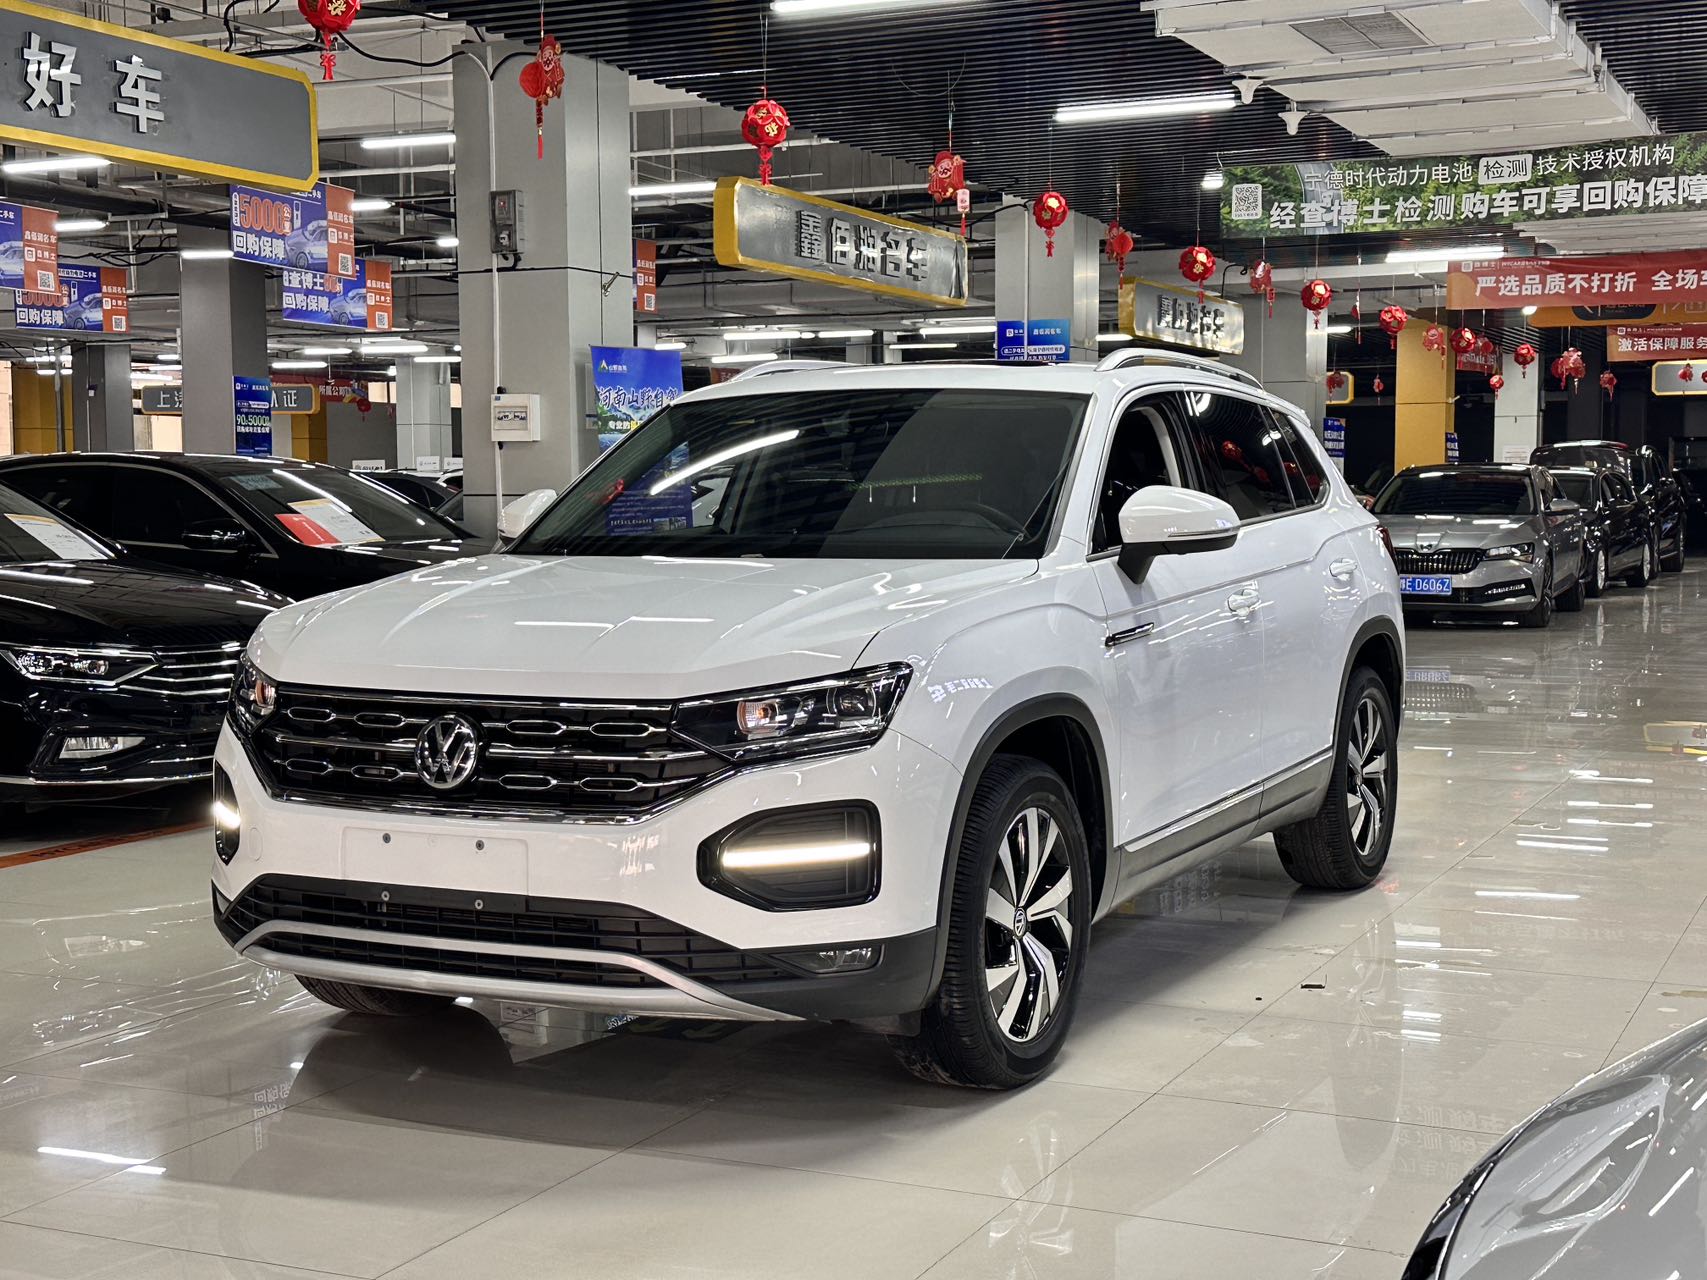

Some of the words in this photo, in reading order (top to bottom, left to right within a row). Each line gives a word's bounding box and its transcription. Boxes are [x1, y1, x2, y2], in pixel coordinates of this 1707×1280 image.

[22, 31, 165, 133] 好车
[1304, 163, 1473, 191] 宁德时代动力电池
[1483, 158, 1527, 180] 检测
[1537, 143, 1675, 175] 技术授权机构
[232, 230, 286, 260] 回购保障
[288, 271, 324, 290] 查博士
[1475, 272, 1638, 297] 严选品质不打折
[1651, 269, 1707, 291] 全场
[283, 292, 330, 313] 回购保障
[16, 308, 64, 326] 回购保障
[1618, 336, 1707, 352] 激活保障服务
